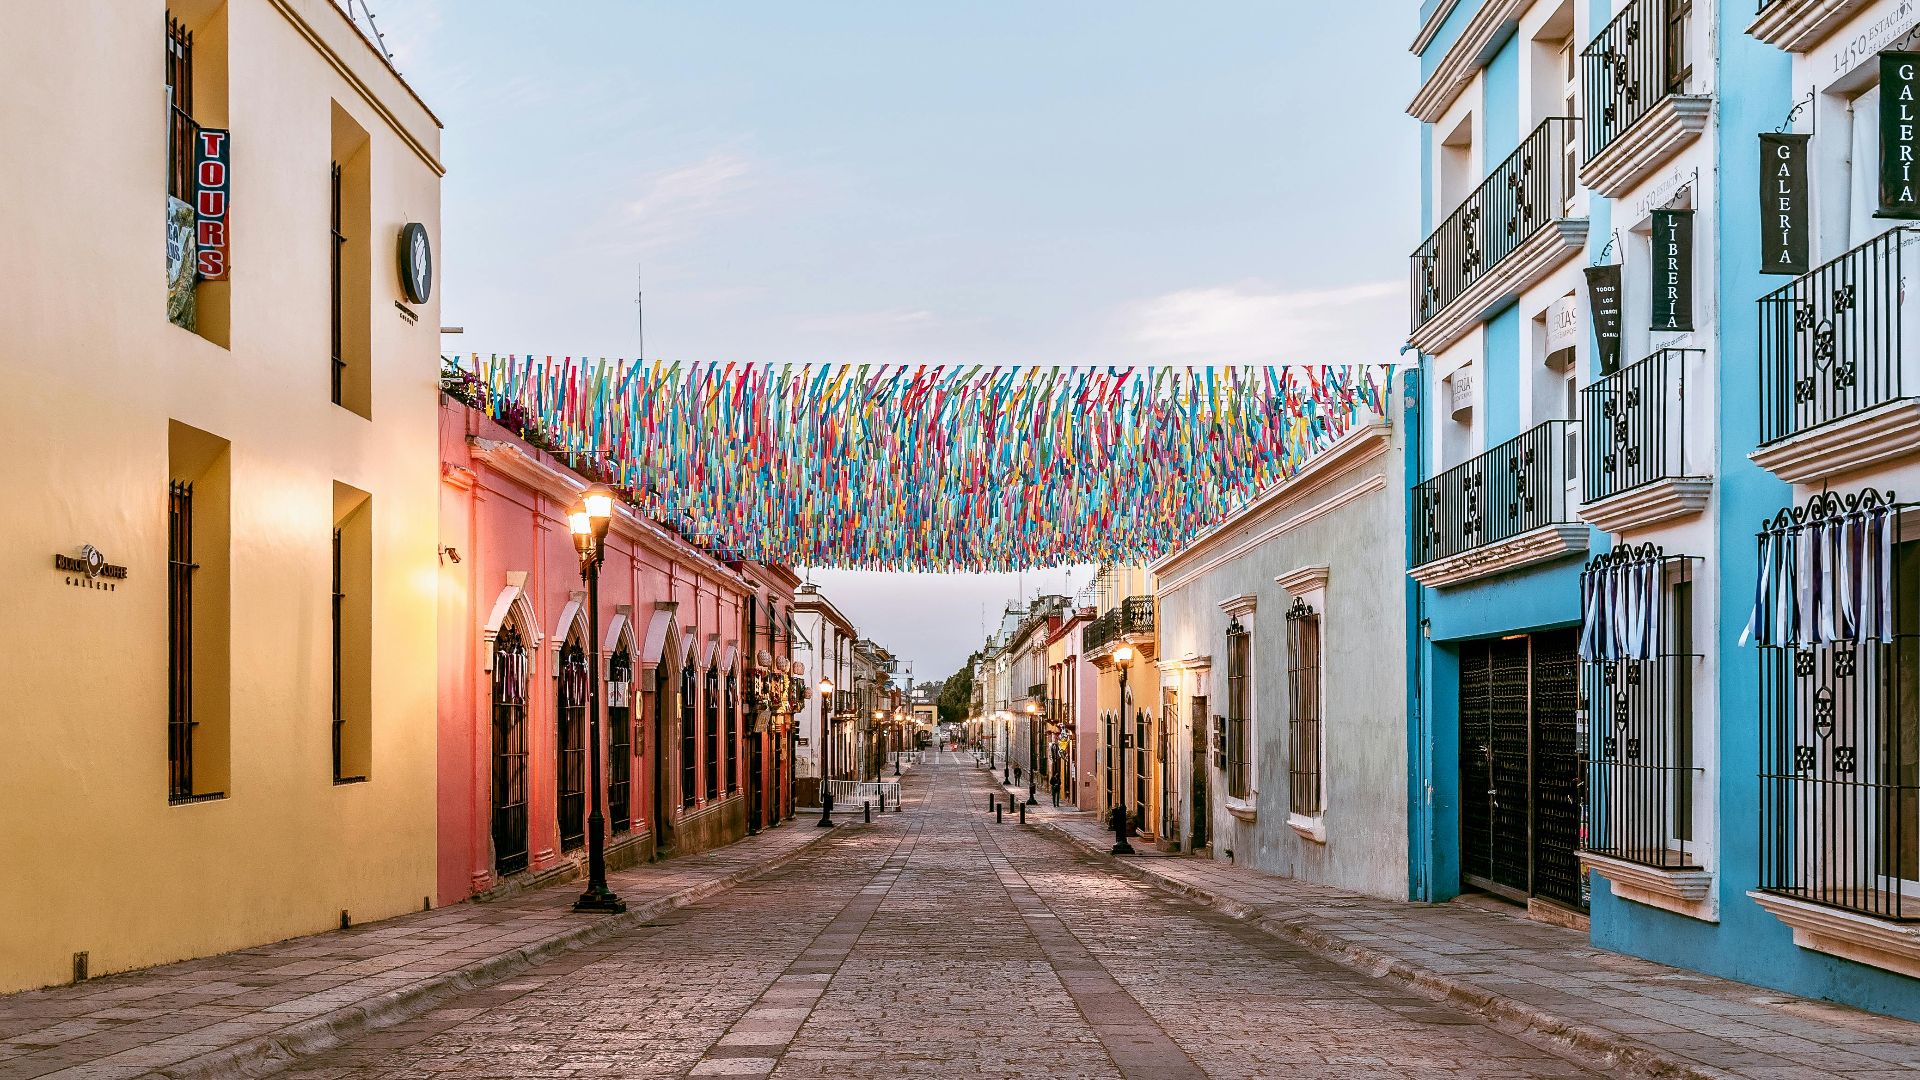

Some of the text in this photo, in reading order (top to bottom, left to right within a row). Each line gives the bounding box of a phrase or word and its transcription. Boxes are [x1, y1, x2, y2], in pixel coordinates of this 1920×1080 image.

[1833, 34, 1867, 74] 1450
[1899, 64, 1914, 202] GALERÍA
[198, 132, 225, 276] TOURS
[1777, 145, 1792, 264] GALERÍA
[1667, 214, 1679, 328] LIBRERÍA
[65, 576, 115, 592] GALLERY
